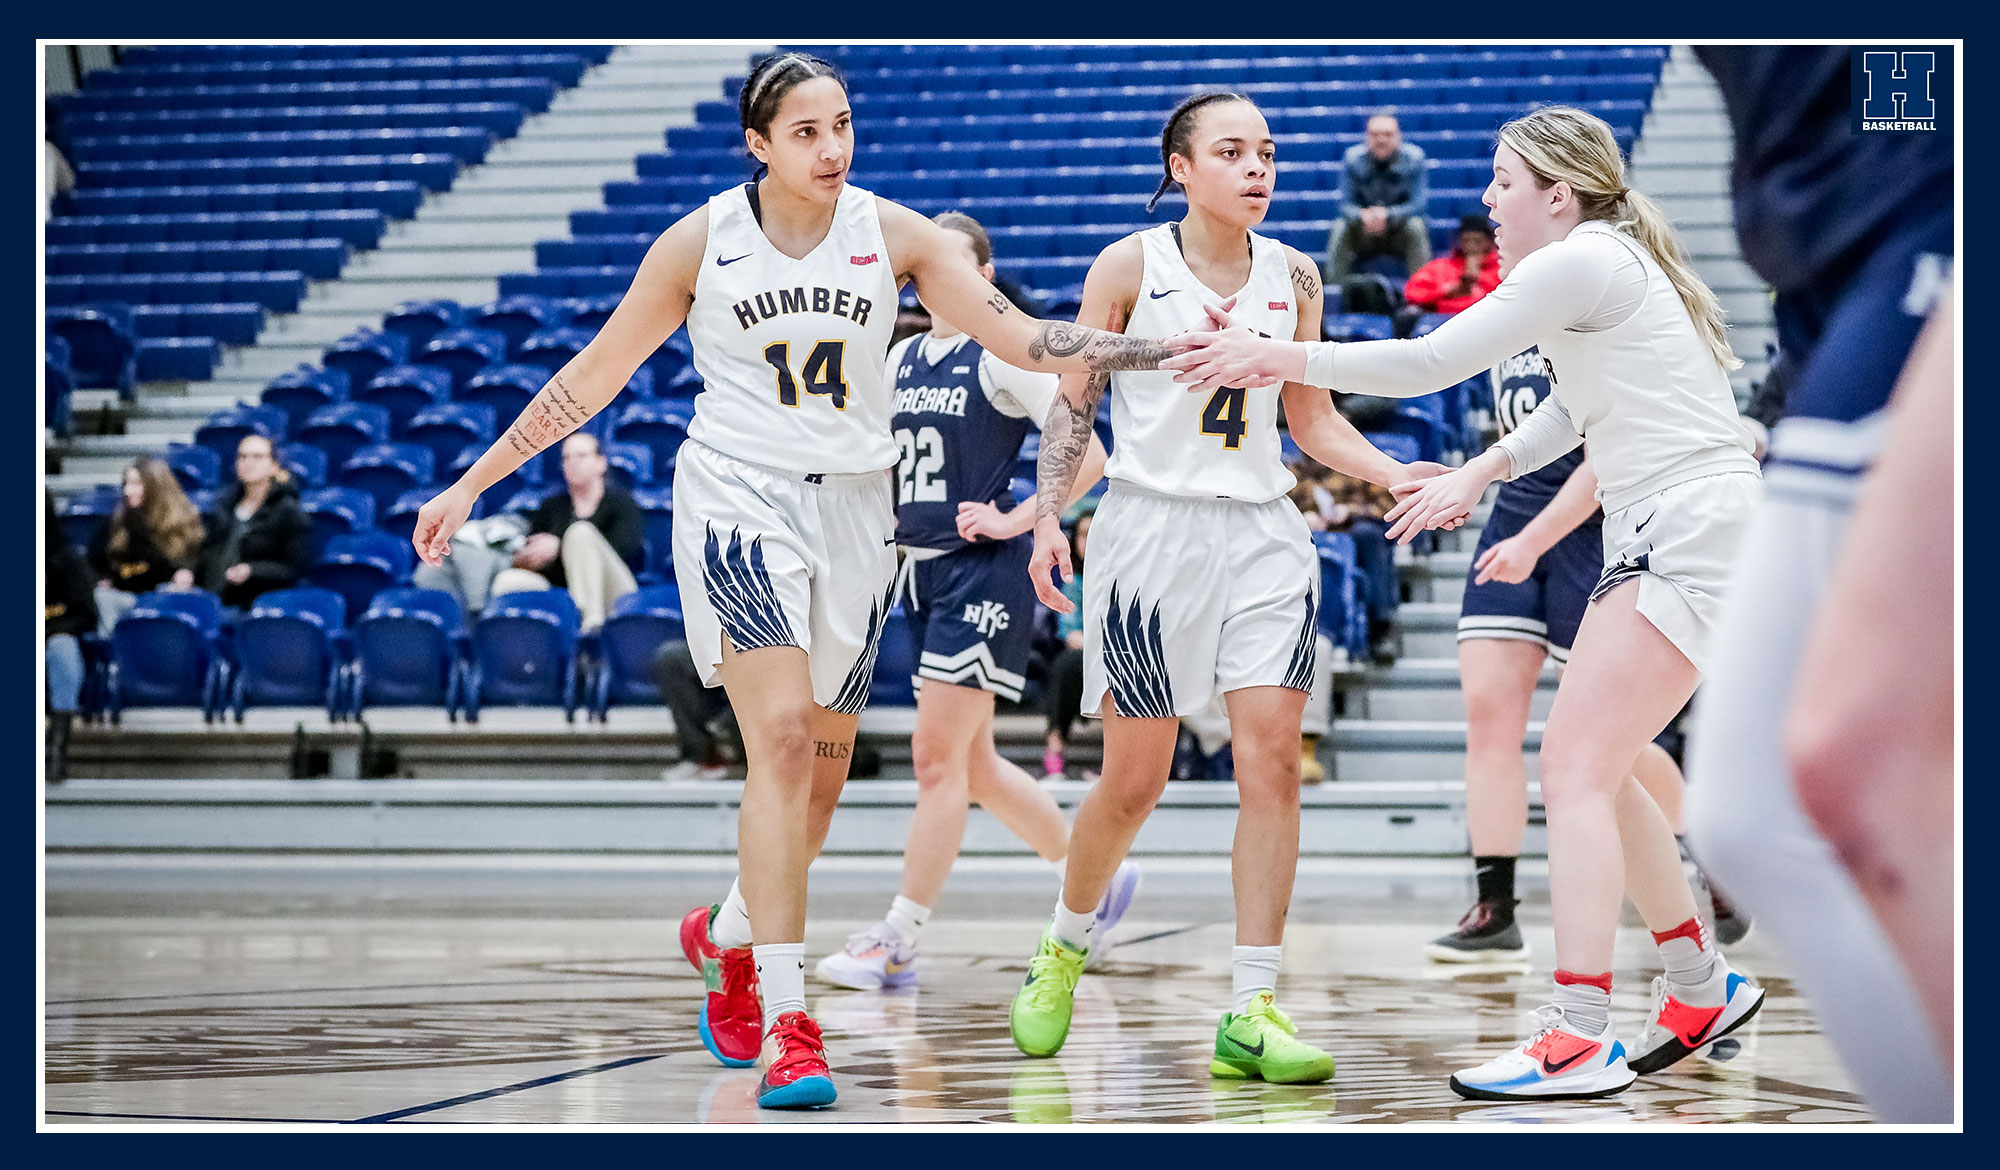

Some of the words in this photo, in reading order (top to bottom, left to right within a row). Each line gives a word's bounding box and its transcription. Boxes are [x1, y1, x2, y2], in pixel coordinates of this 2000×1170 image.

[732, 287, 872, 331] HUMBER
[762, 339, 850, 411] 14
[1200, 385, 1249, 450] 4
[894, 427, 948, 506] 22
[962, 600, 1010, 638] NKC
[813, 740, 851, 759] RUS
